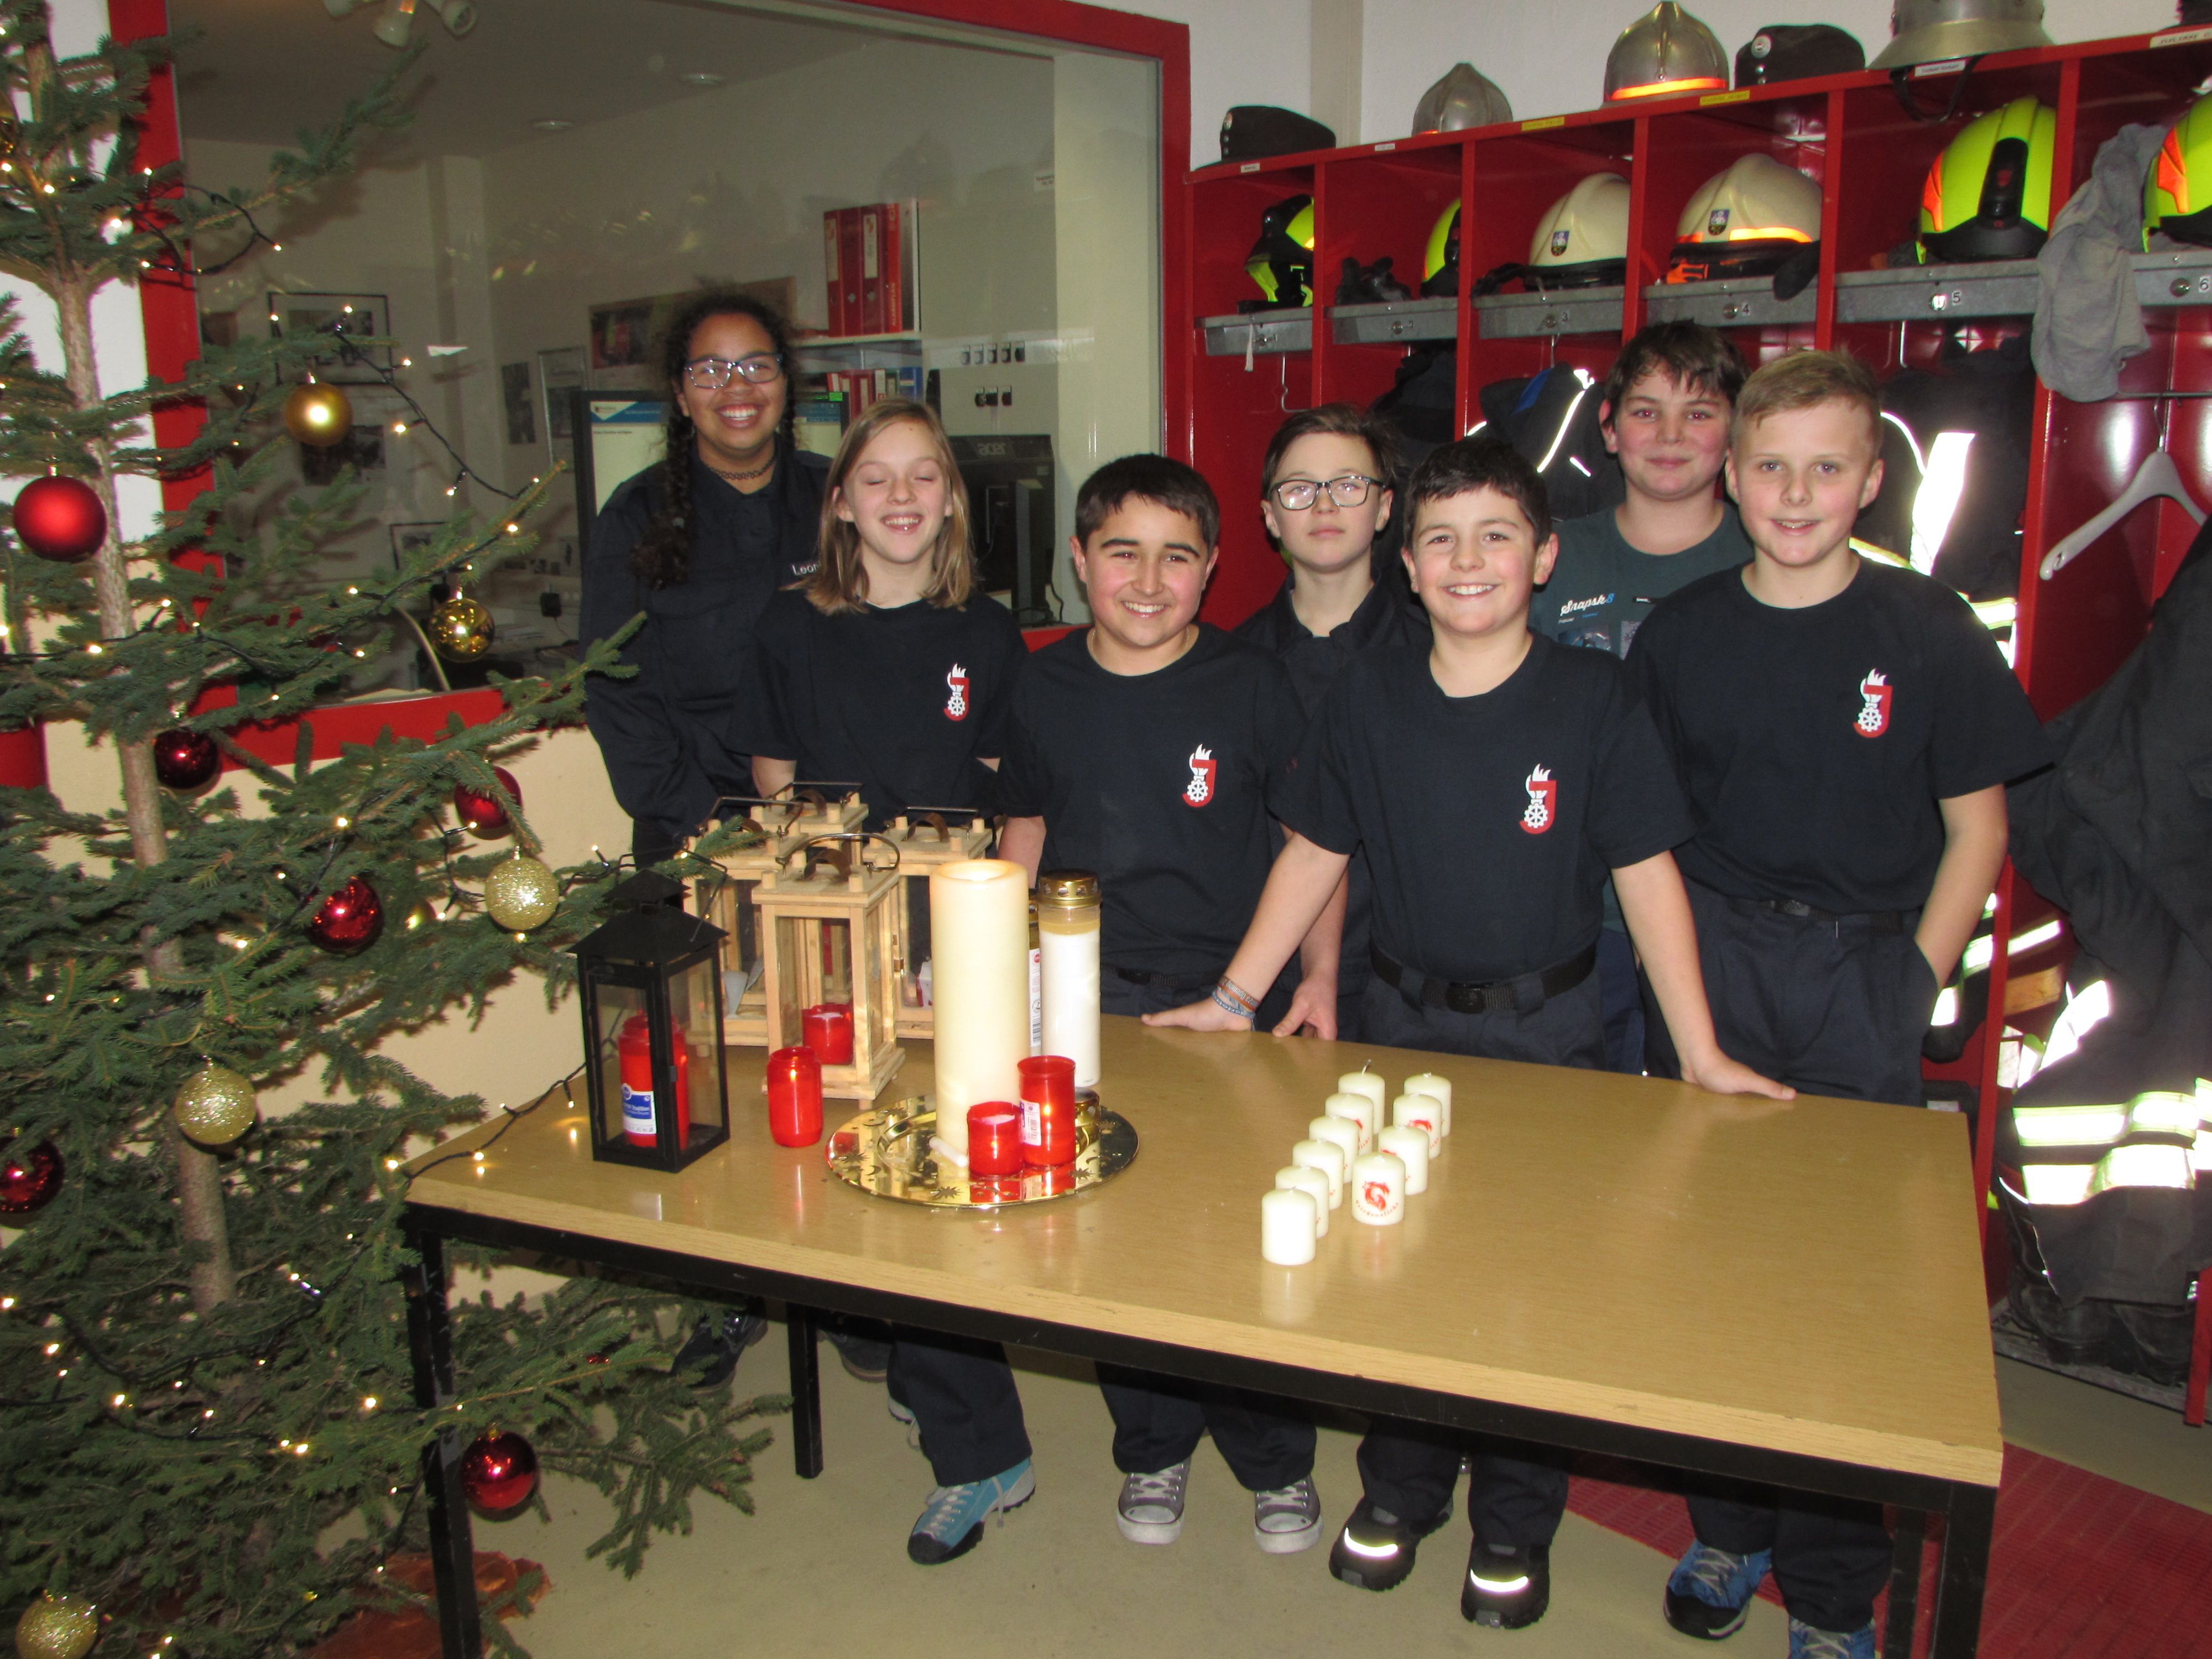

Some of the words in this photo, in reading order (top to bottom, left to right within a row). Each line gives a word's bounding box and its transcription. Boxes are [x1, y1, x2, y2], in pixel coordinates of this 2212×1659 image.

[2200, 278, 2209, 291] 6
[1953, 291, 1961, 304] 5
[1742, 304, 1750, 315] 4
[1562, 311, 1568, 322] 3
[977, 442, 1006, 455] acer
[1559, 592, 1615, 617] Snapsk8
[1355, 1199, 1399, 1218] Friedenslicht
